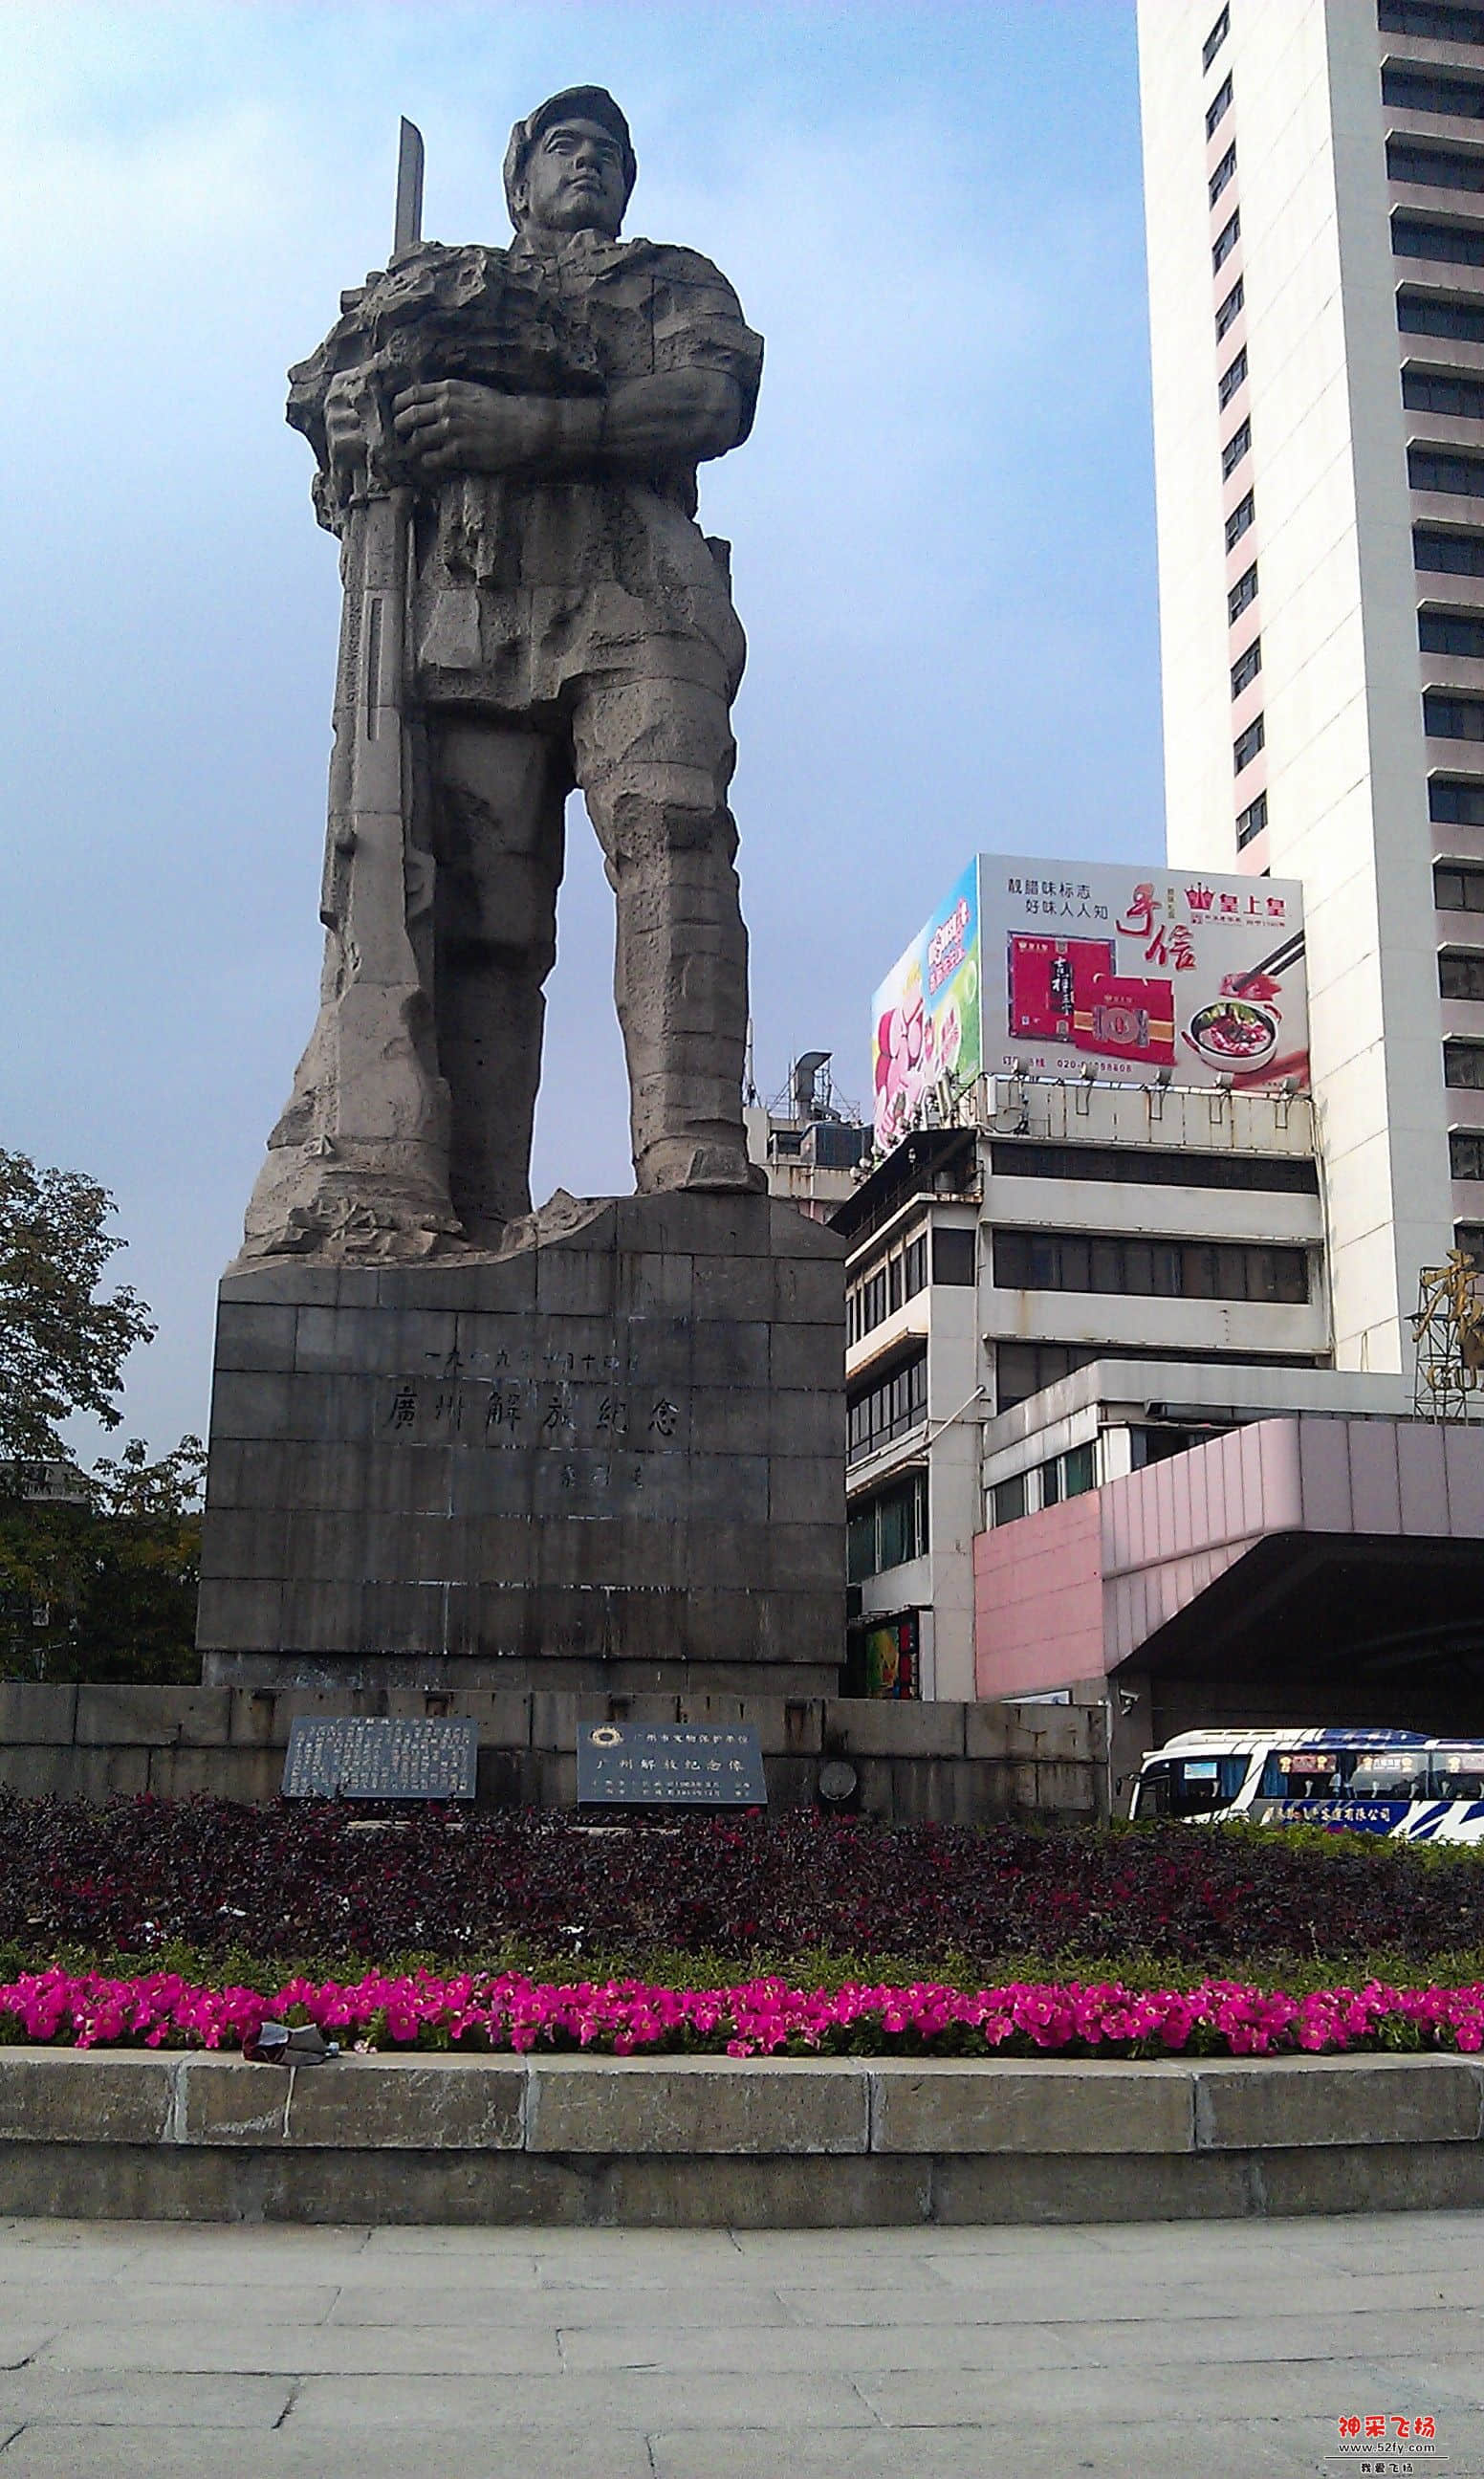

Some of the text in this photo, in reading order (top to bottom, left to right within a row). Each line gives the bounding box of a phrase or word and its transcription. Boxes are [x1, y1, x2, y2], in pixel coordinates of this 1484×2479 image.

[1008, 878, 1091, 899] 靓腊味标志
[1025, 899, 1109, 919] 好味人人知
[1219, 893, 1286, 917] 皇上皇
[1002, 1056, 1045, 1067] 订线
[1057, 1059, 1132, 1072] 020-98608
[1428, 1365, 1484, 1393] GU
[384, 1387, 679, 1437] 廣州解放紀念
